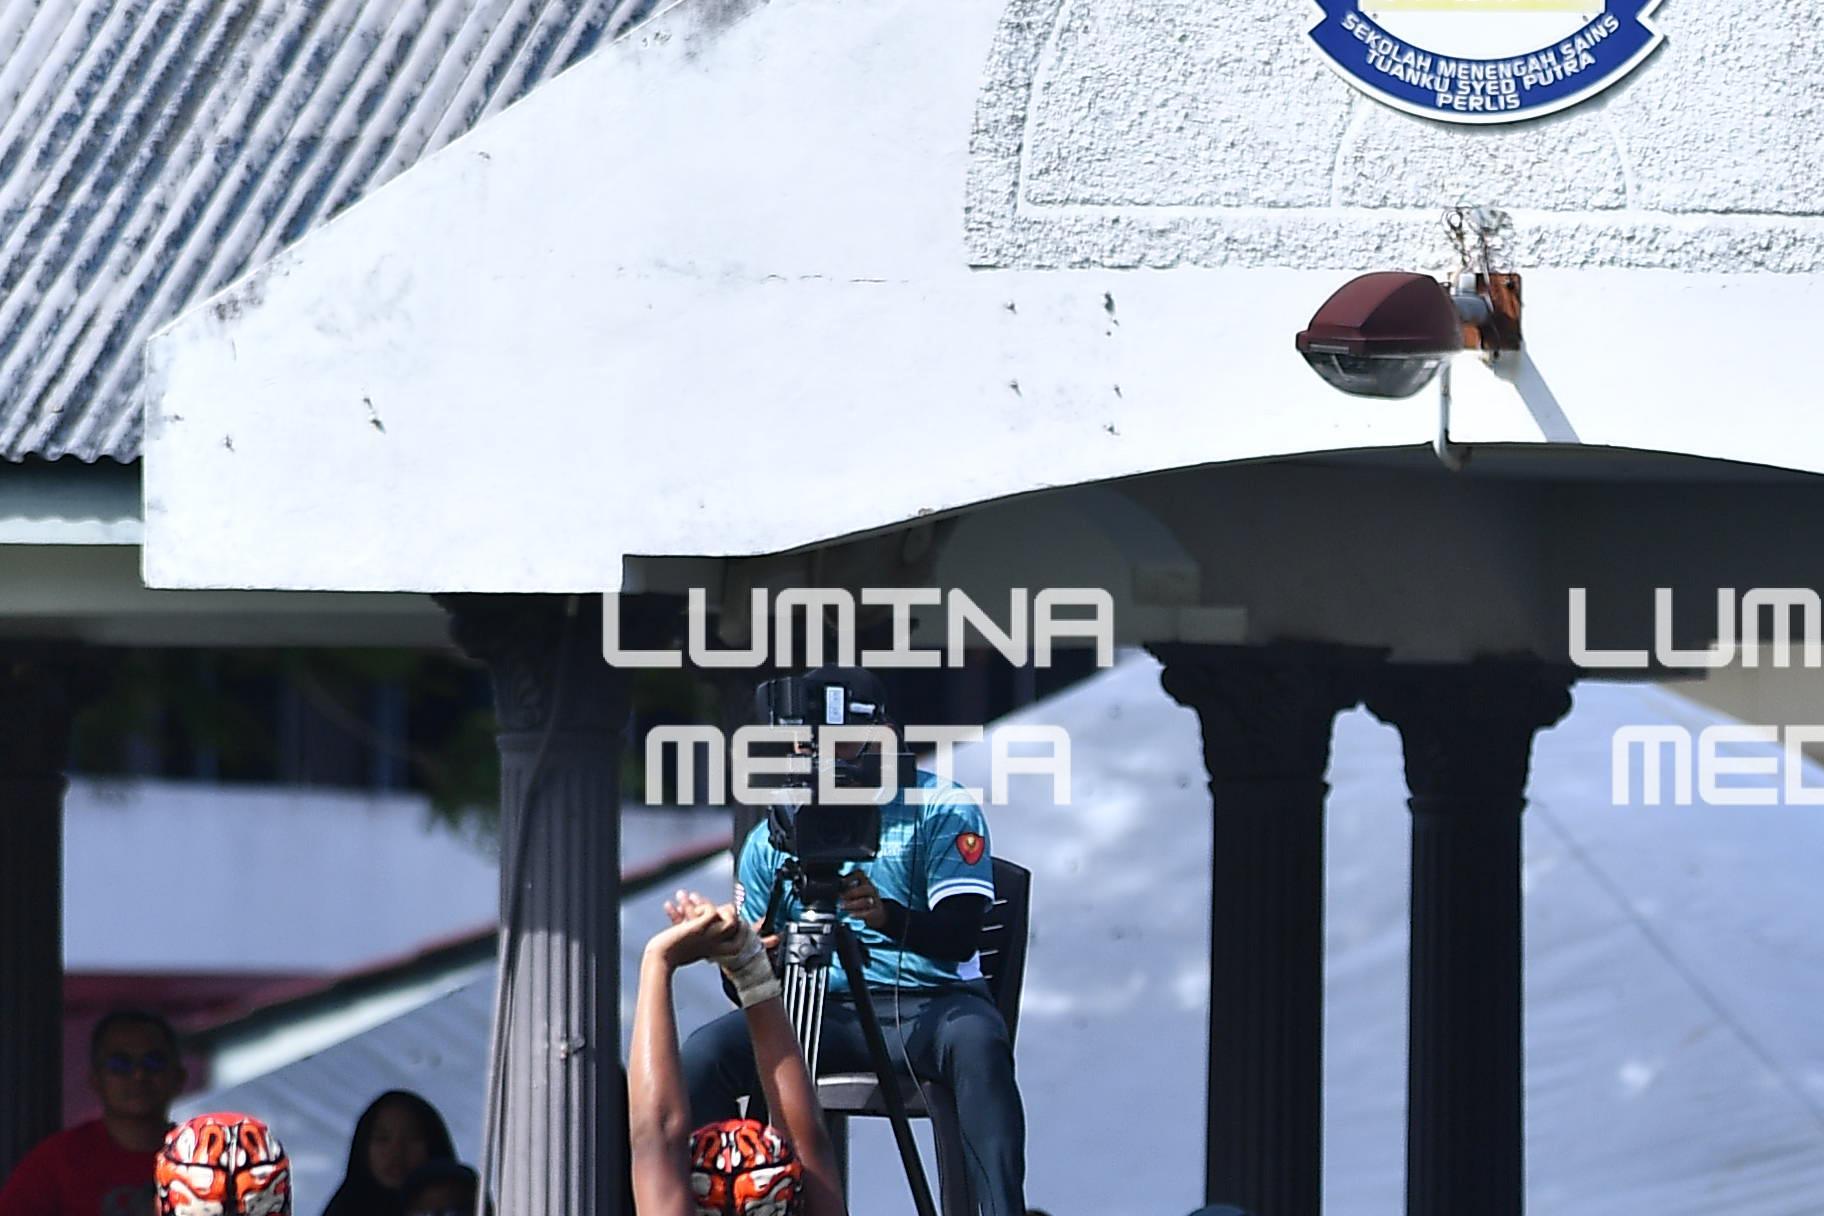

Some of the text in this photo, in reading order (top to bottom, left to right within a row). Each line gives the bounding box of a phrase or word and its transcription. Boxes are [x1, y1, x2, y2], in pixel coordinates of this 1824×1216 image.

[1341, 14, 1621, 79] SEKOLAH MENENGAH SAINS
[1367, 51, 1596, 97] TUANKU SYED PUTRA
[1437, 93, 1521, 111] PERLIS
